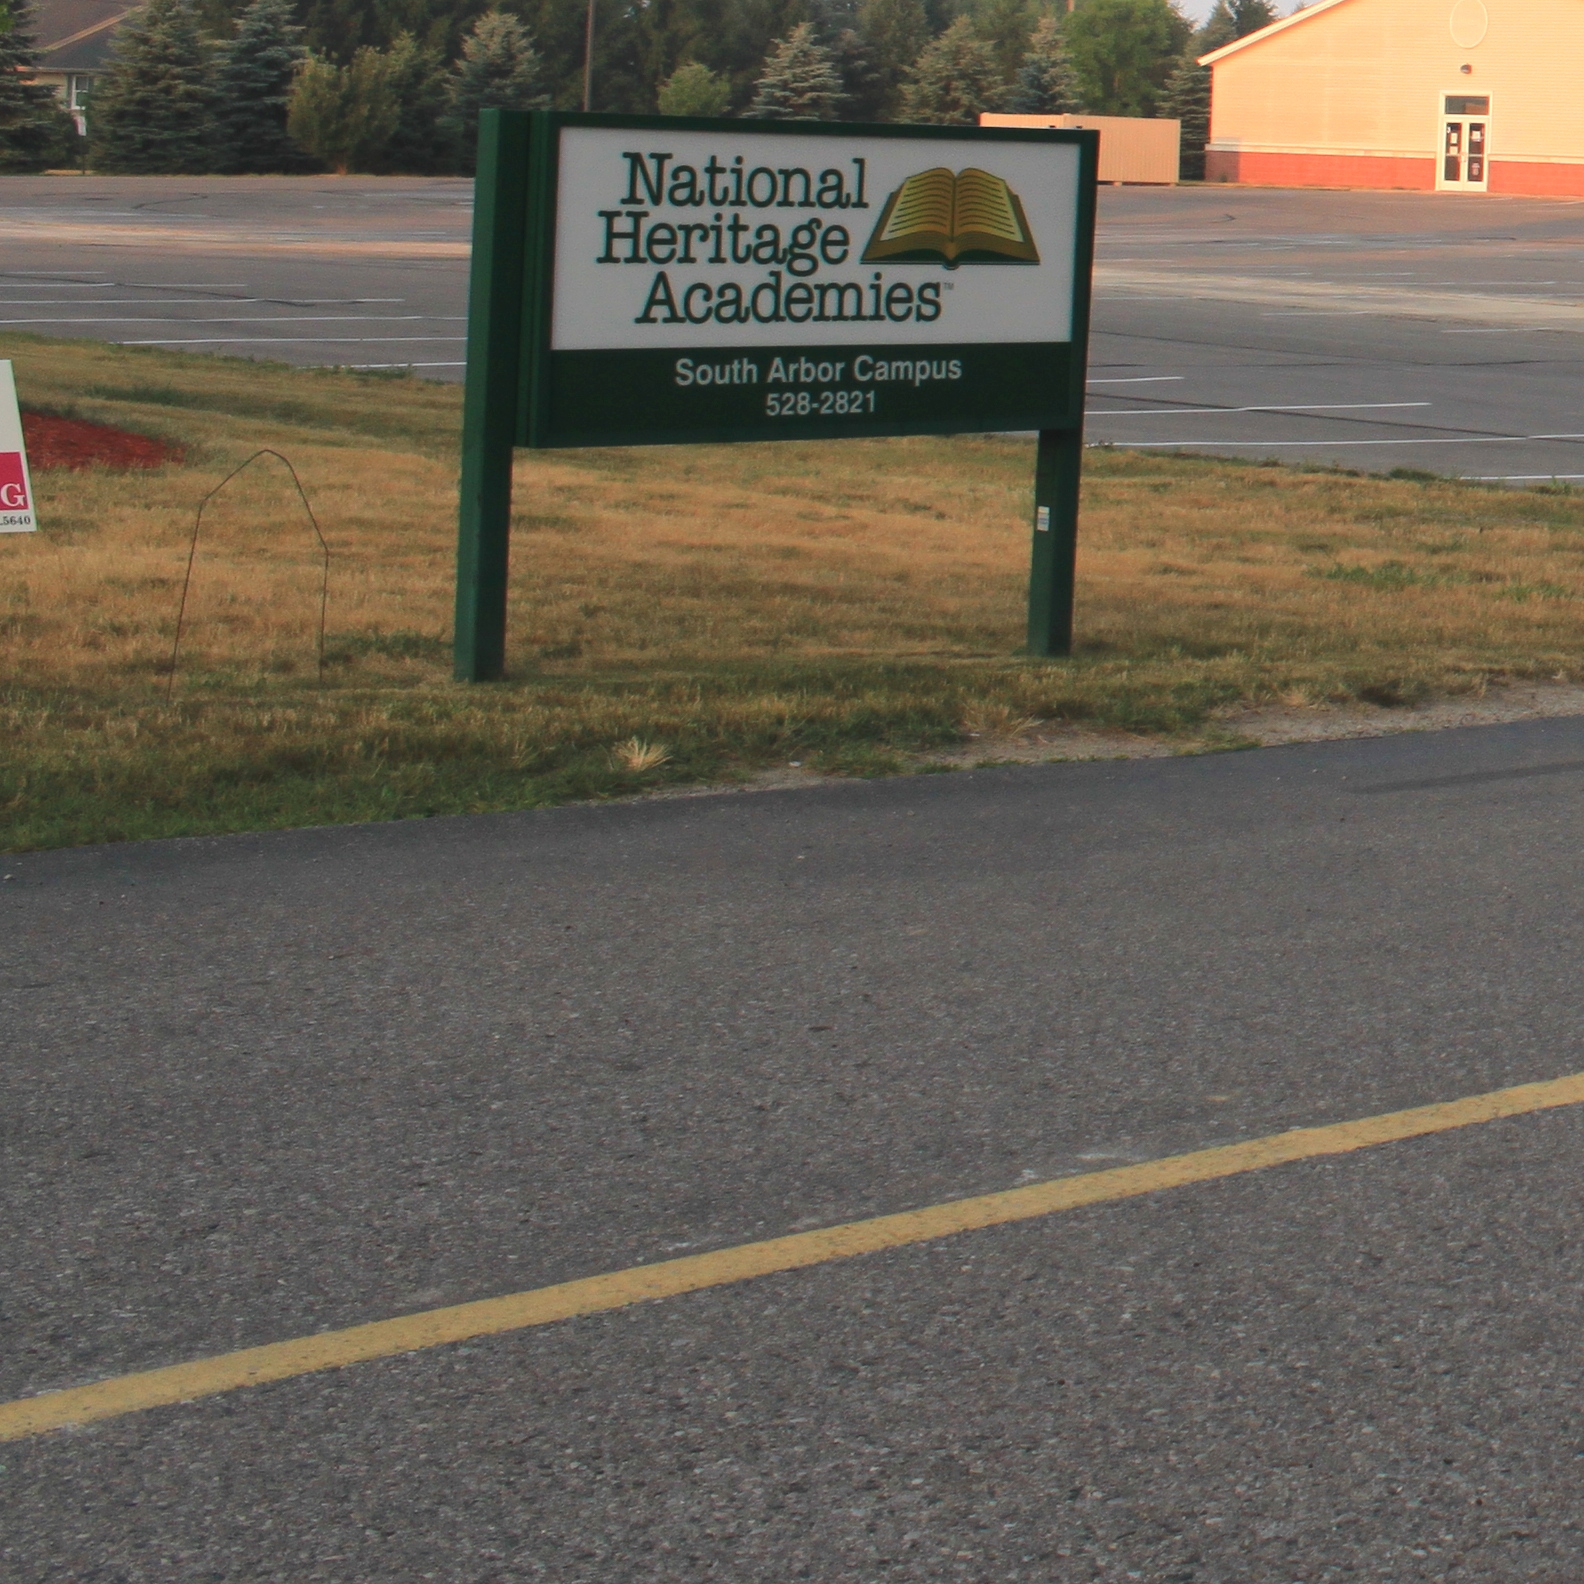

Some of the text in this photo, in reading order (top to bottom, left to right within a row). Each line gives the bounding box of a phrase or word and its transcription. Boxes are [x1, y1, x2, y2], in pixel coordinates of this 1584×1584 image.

[620, 151, 869, 209] National
[596, 211, 850, 277] Heritage
[634, 271, 943, 325] Academies
[675, 354, 963, 387] South Arbor Campus
[765, 390, 876, 416] 528-2821
